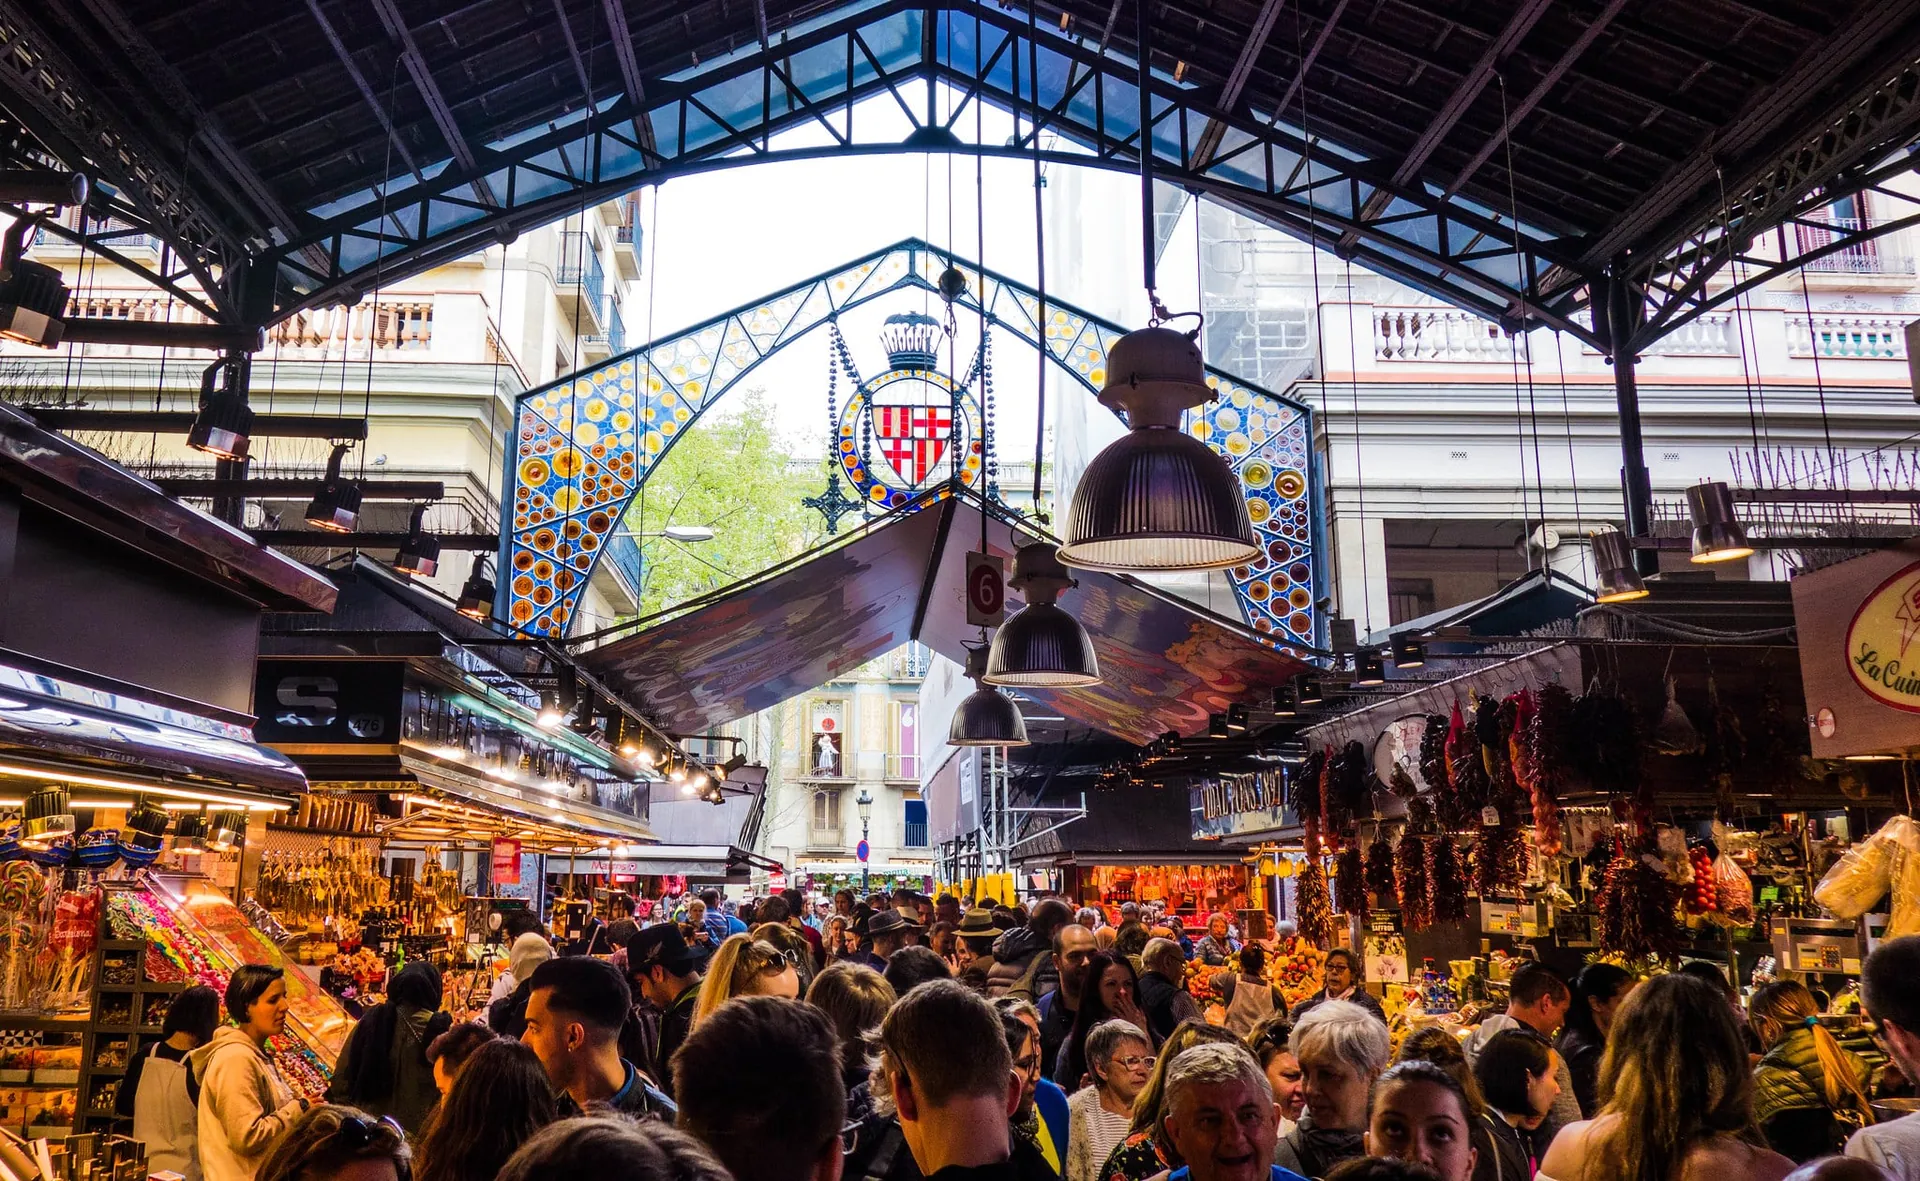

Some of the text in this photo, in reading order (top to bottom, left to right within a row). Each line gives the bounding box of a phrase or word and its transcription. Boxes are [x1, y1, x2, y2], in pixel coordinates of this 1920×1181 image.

[979, 573, 994, 606] 6
[1854, 643, 1881, 681] La
[276, 676, 380, 732] S 476
[1200, 779, 1229, 819] VIDAL
[1231, 775, 1256, 814] PONS
